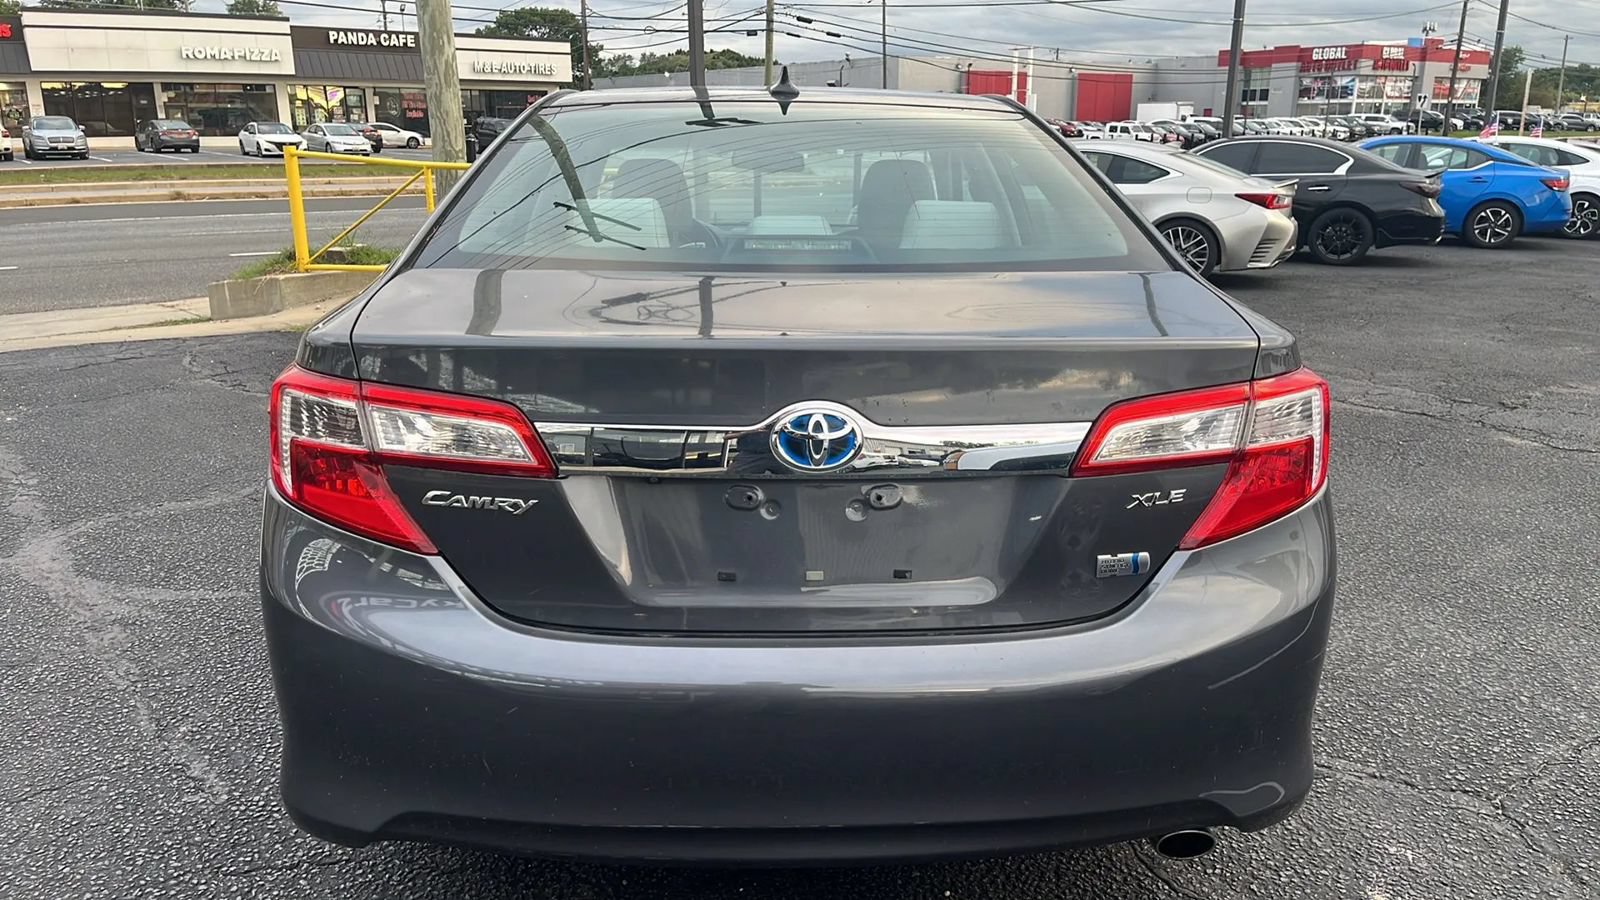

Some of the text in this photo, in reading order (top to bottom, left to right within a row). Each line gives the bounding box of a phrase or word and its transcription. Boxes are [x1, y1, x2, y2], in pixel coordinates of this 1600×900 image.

[0, 23, 12, 38] S
[328, 30, 416, 48] PANDA CAFE
[181, 45, 282, 61] ROMA PIZZA
[1312, 46, 1348, 61] GLOBAL
[500, 62, 528, 74] AUTO
[529, 63, 558, 76] TIRES
[421, 490, 539, 515] CAMRY
[1126, 488, 1187, 509] XLE
